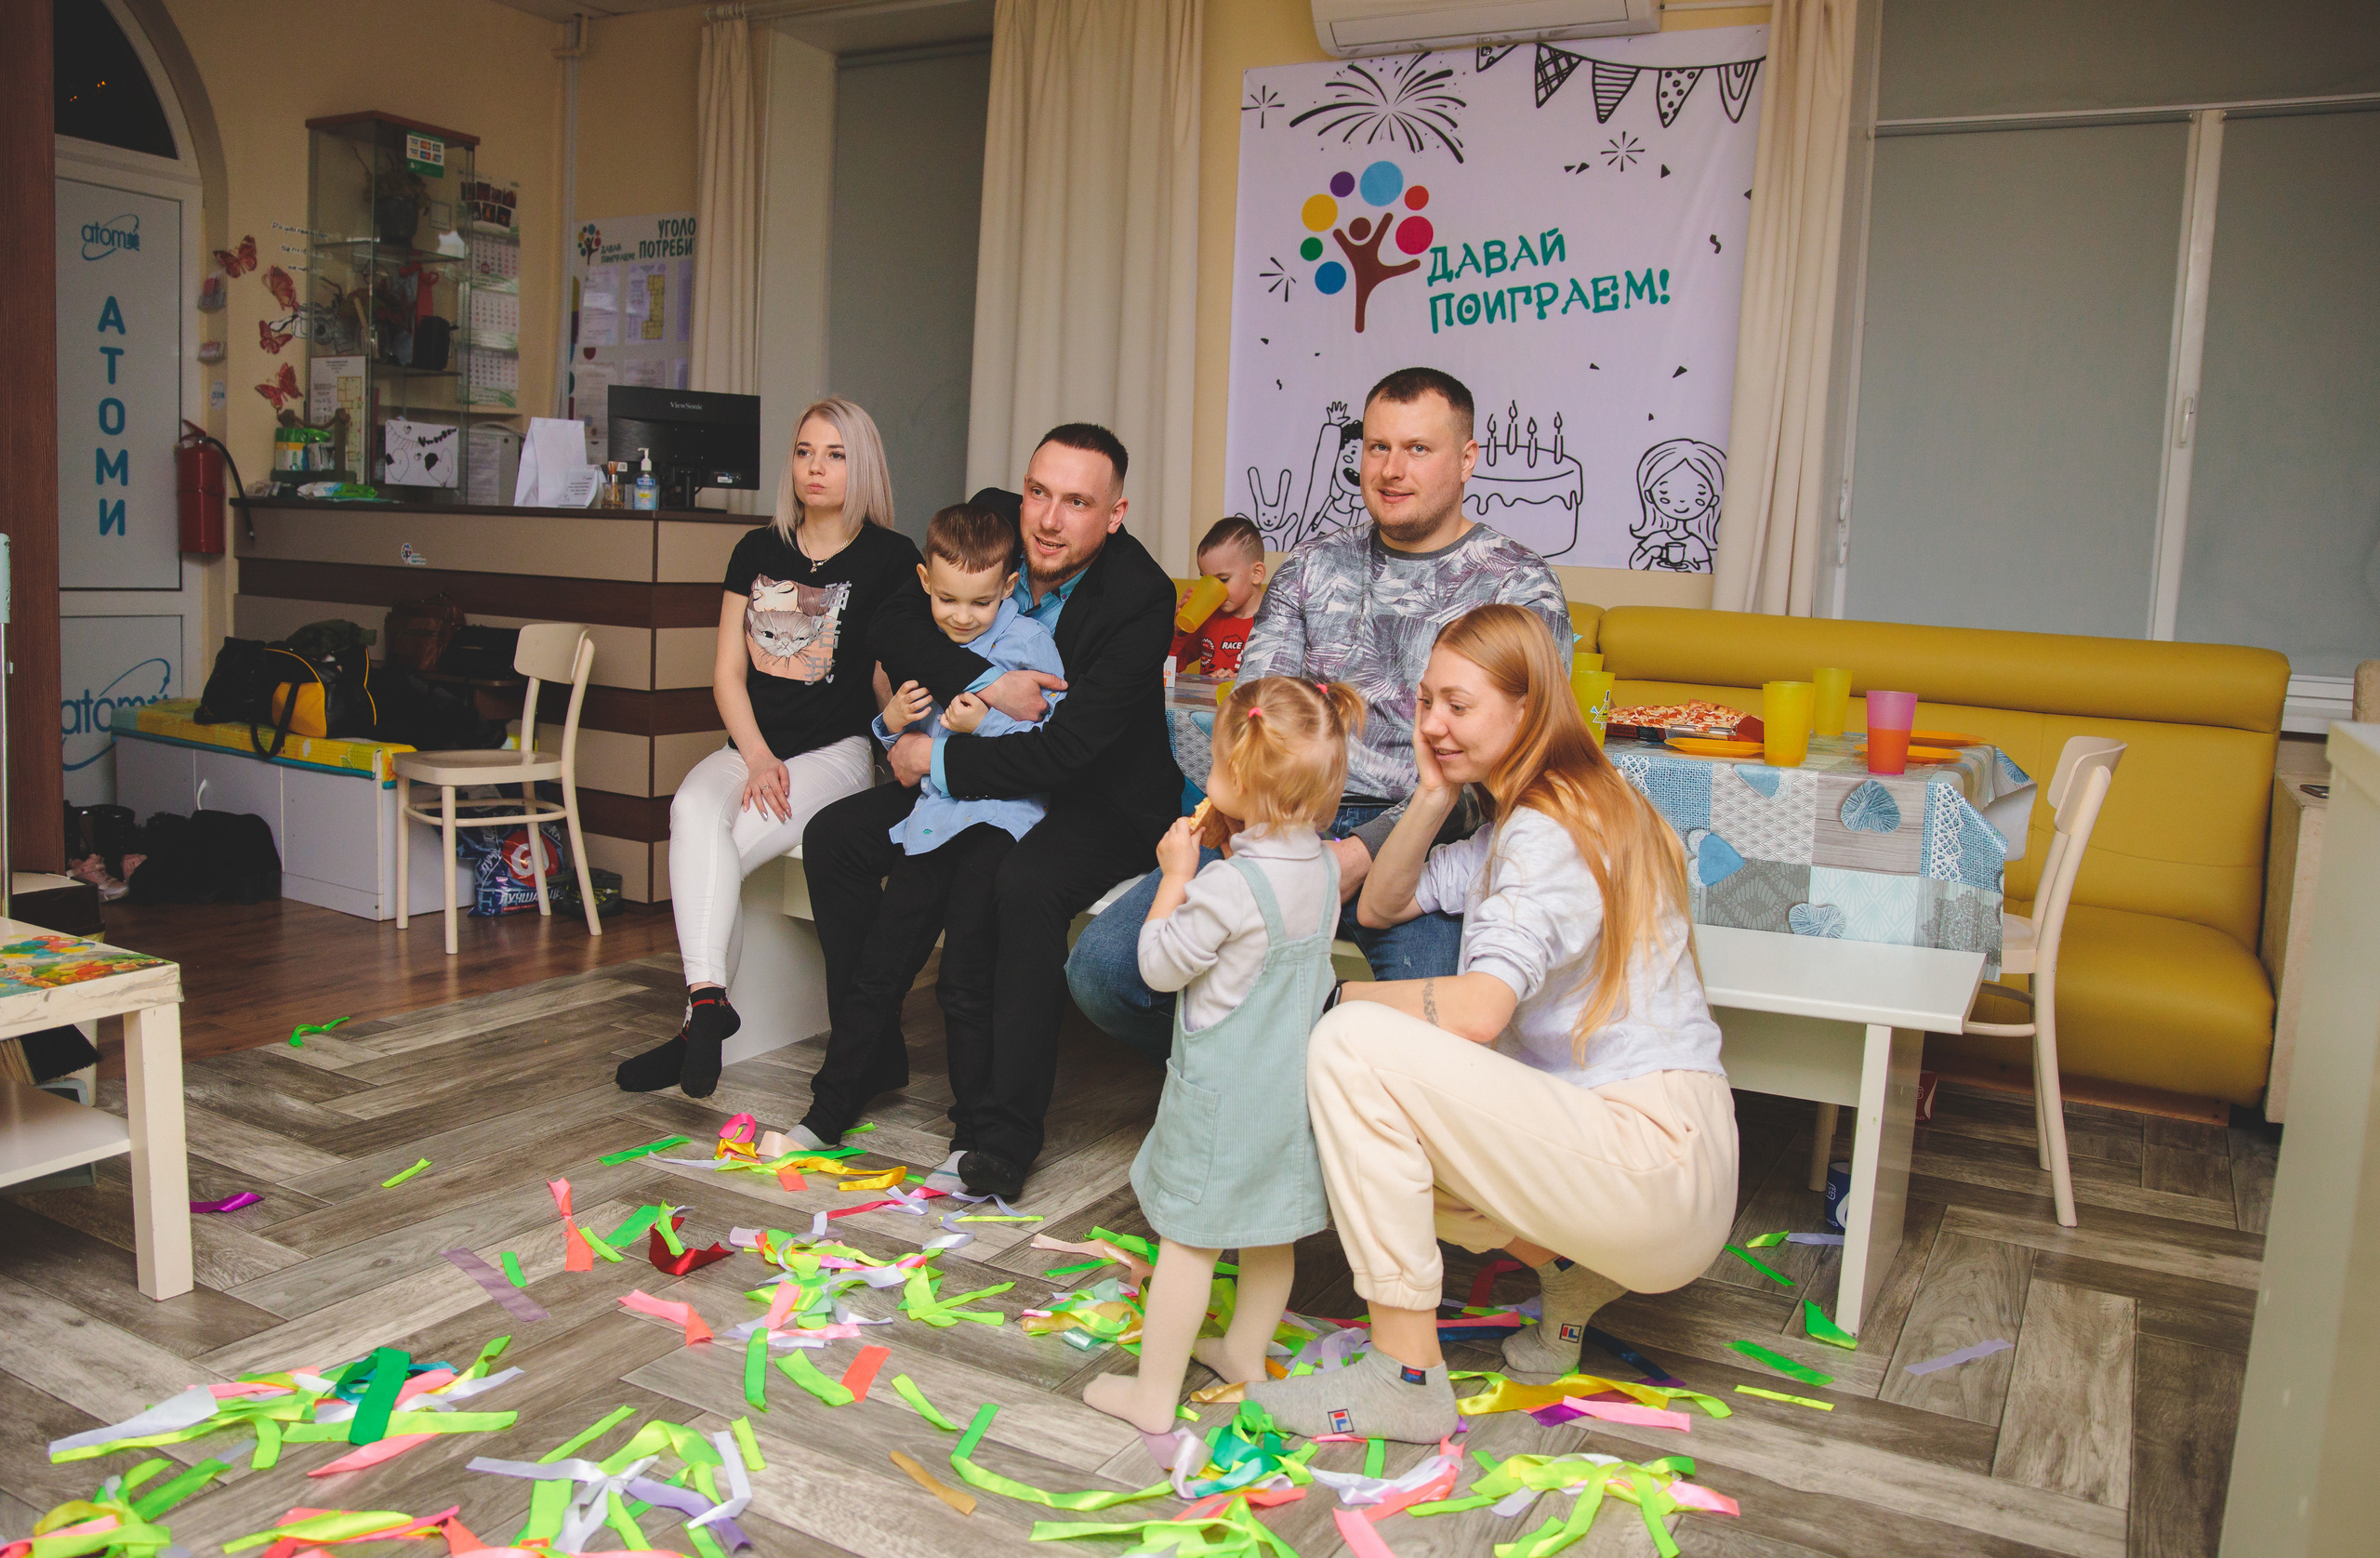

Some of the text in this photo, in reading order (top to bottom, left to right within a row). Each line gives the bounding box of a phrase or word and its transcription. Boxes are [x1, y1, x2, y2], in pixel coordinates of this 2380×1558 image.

[639, 238, 696, 258] ПОТРЕБИ
[1427, 227, 1567, 287] ДАВАЙ
[1428, 269, 1672, 334] ПОИГРАЕМ!
[669, 401, 704, 411] ViewSonic
[1222, 641, 1243, 650] RACE
[498, 891, 539, 905] ЛУЧША
